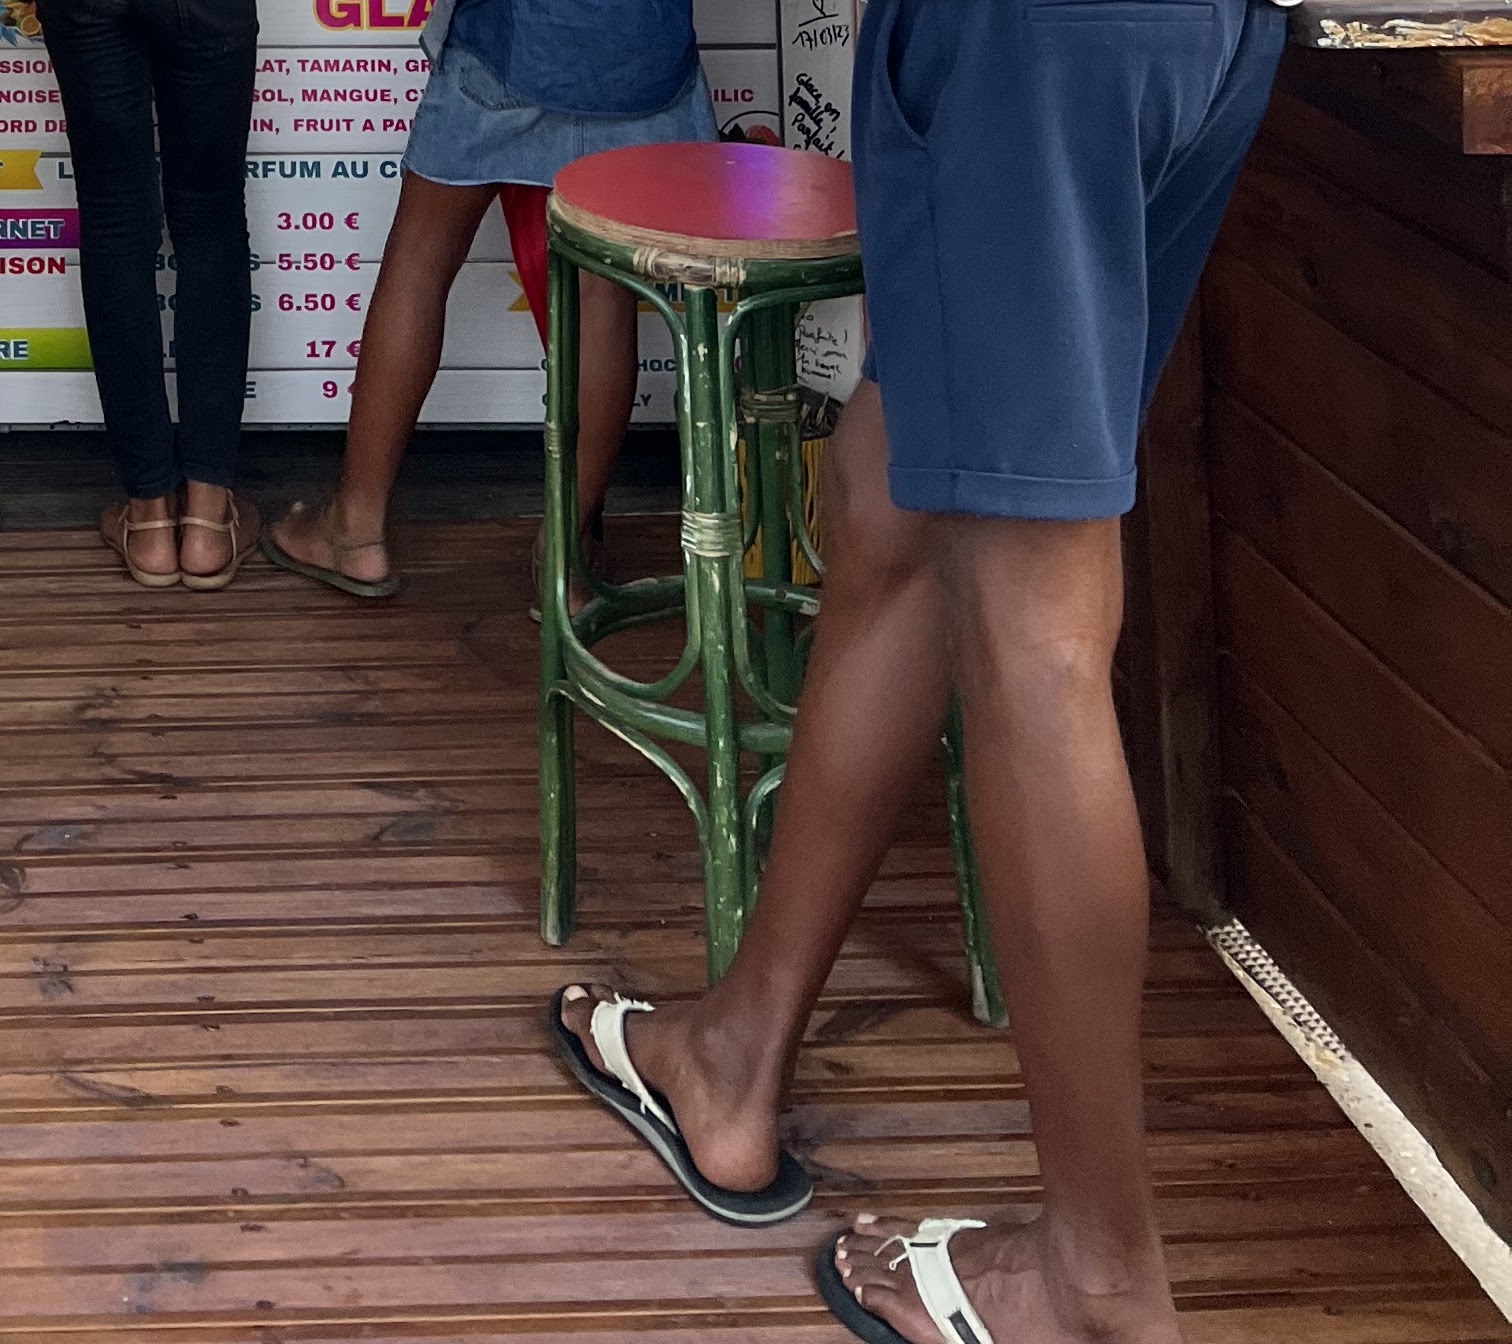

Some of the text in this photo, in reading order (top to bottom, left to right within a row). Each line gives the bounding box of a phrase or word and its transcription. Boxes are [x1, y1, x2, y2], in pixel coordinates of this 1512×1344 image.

[792, 24, 851, 50] 17/03/23
[297, 59, 397, 75] TAMARIN,
[302, 89, 397, 105] MANGUE,
[294, 119, 375, 132] FRUIT A
[331, 161, 368, 178] AU
[278, 213, 359, 230] 3.00 €
[278, 253, 360, 271] 5.50 €
[279, 294, 361, 311] 6.50 €
[307, 341, 336, 357] 17
[323, 381, 337, 398] 9
